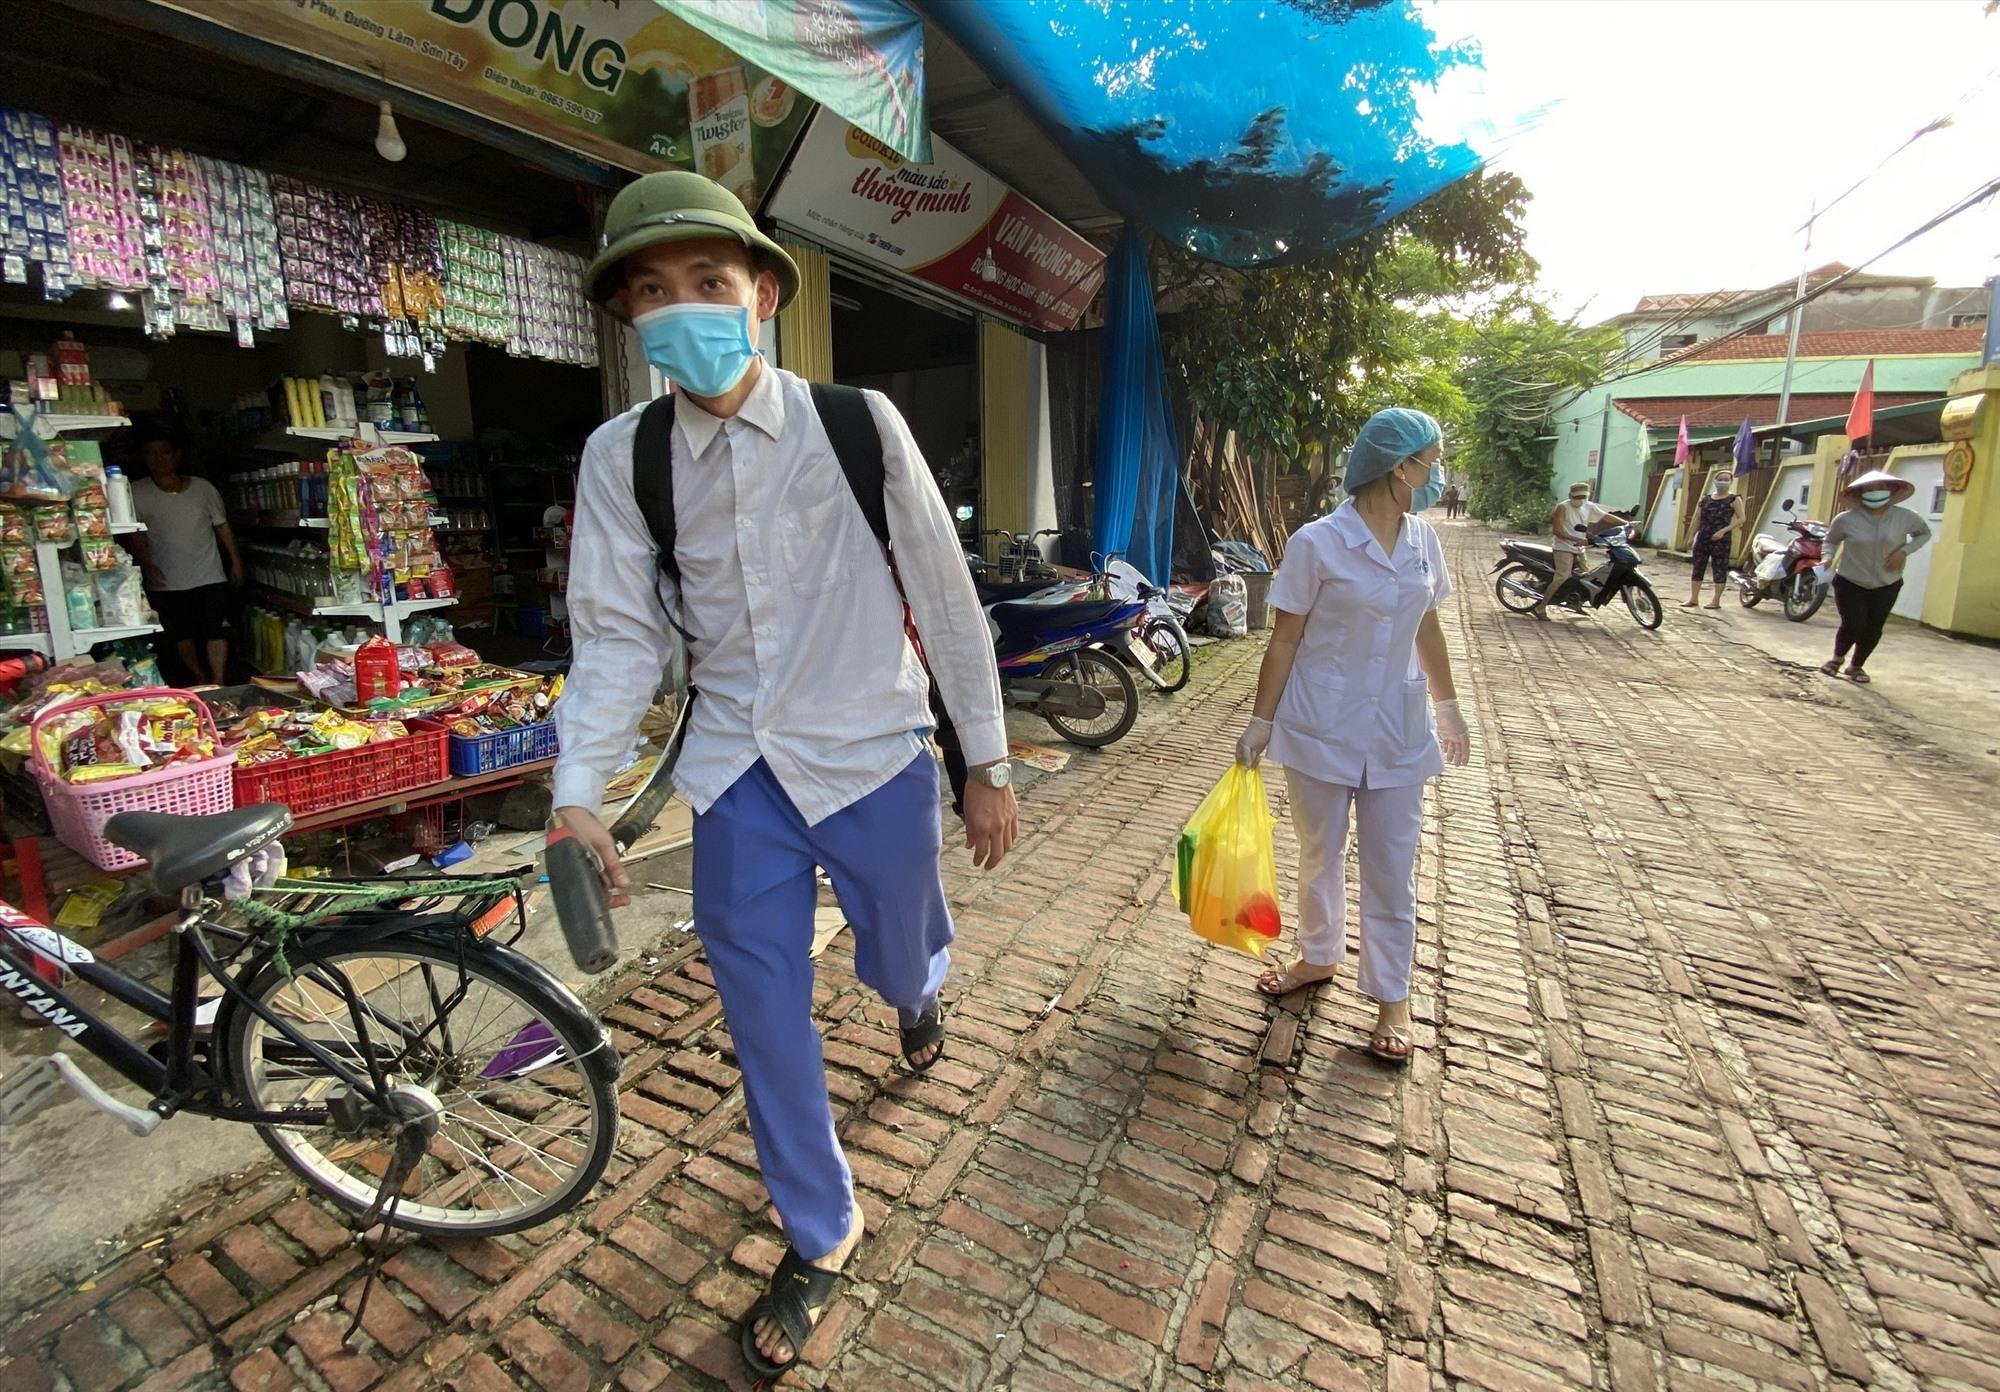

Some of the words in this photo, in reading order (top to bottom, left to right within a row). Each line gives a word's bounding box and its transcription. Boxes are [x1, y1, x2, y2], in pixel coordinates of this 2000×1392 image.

[421, 41, 443, 59] Sơn
[446, 51, 467, 70] Tây
[650, 141, 677, 157] A&C
[897, 168, 928, 188] màu
[927, 170, 949, 190] sắc
[851, 166, 918, 224] thông
[915, 182, 972, 214] minh
[995, 213, 1034, 254] VĂN
